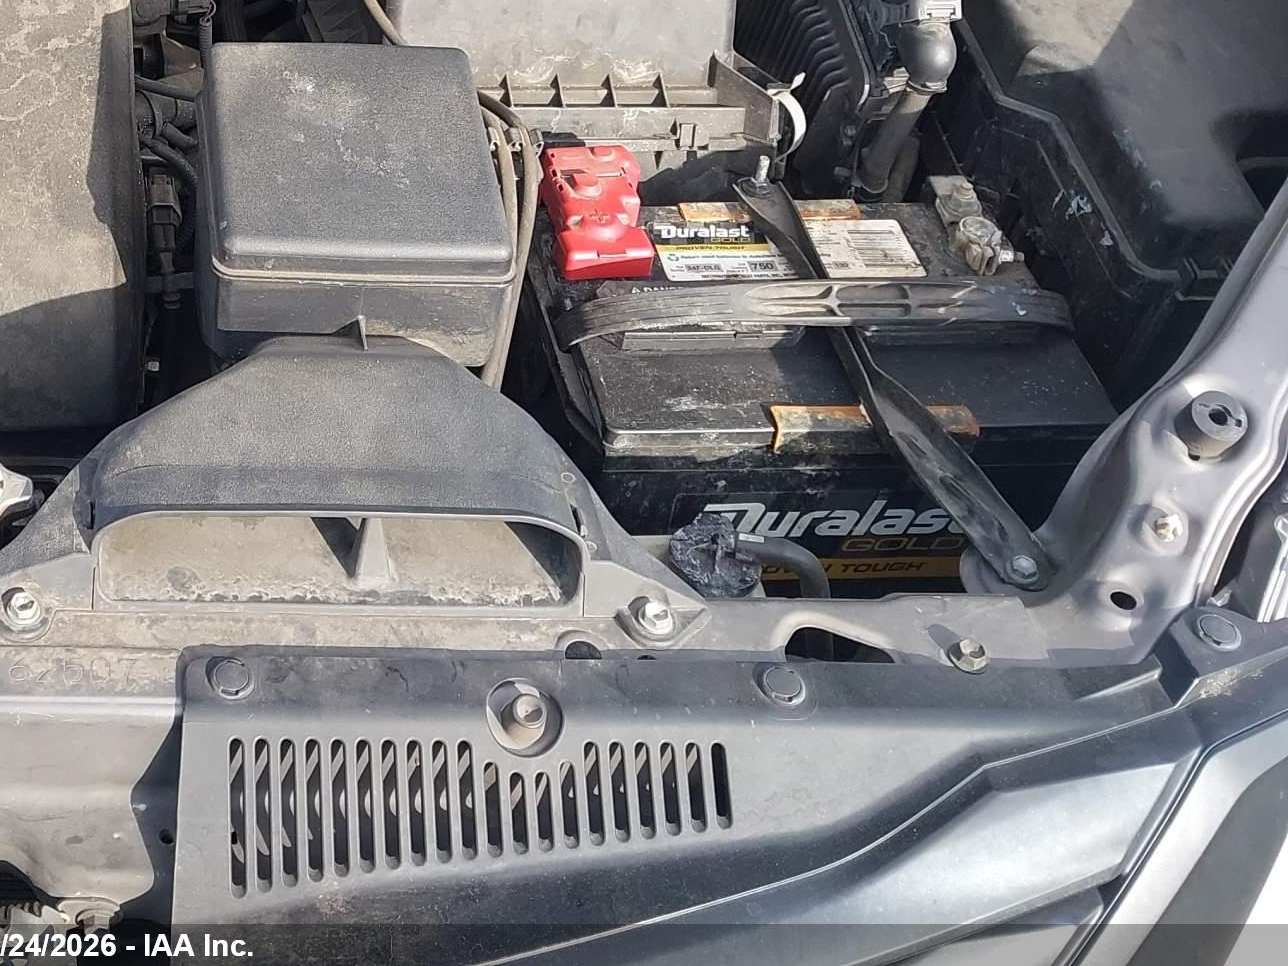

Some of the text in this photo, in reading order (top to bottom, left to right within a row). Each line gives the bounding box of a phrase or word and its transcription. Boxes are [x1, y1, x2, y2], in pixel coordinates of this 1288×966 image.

[654, 224, 750, 239] Duralast
[750, 262, 774, 270] 750
[703, 500, 964, 537] Duralas
[841, 536, 964, 552] GOLD
[841, 561, 925, 573] TOUGH
